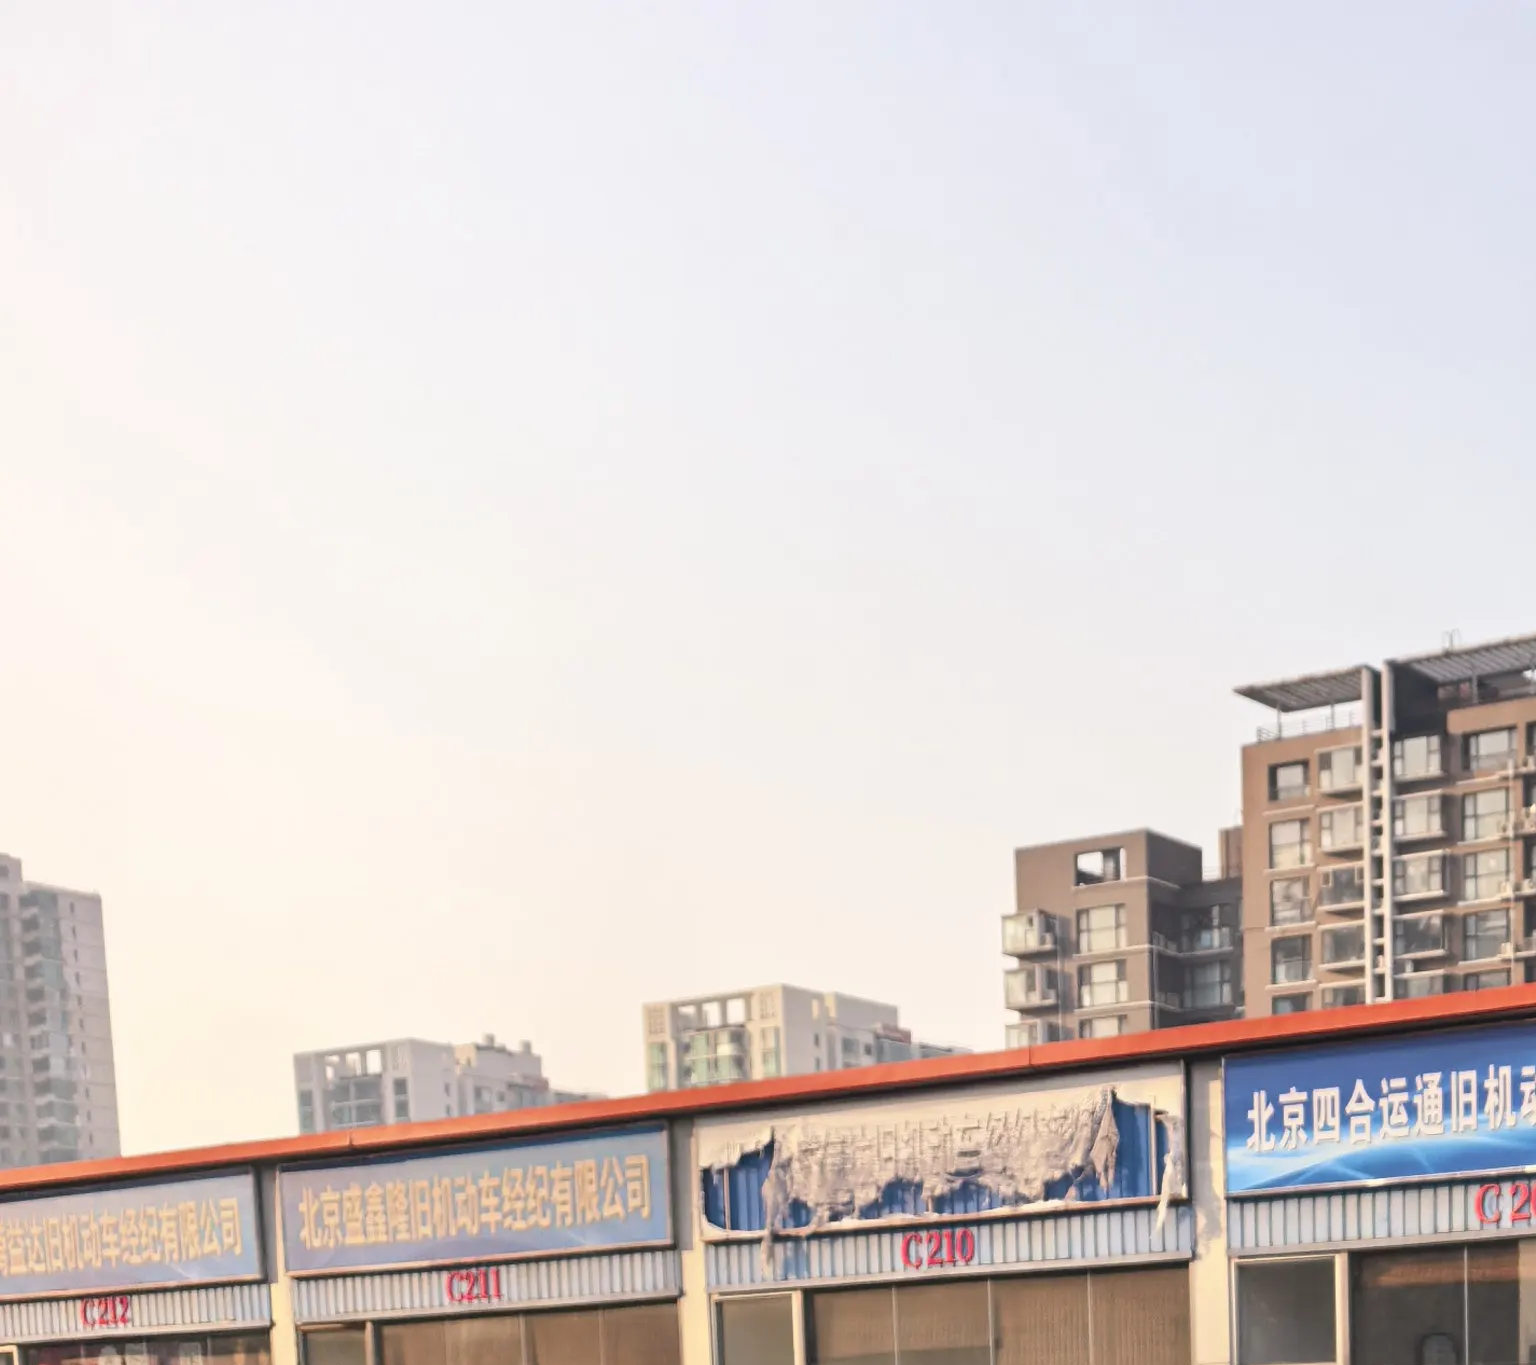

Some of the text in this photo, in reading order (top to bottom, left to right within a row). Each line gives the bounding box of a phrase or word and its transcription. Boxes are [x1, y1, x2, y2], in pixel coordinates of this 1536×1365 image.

[298, 1153, 650, 1250] 北京盛鑫隆旧机动车经纪有限公司
[900, 1227, 976, 1268] C210
[445, 1266, 502, 1303] C211
[80, 1295, 130, 1328] C212
